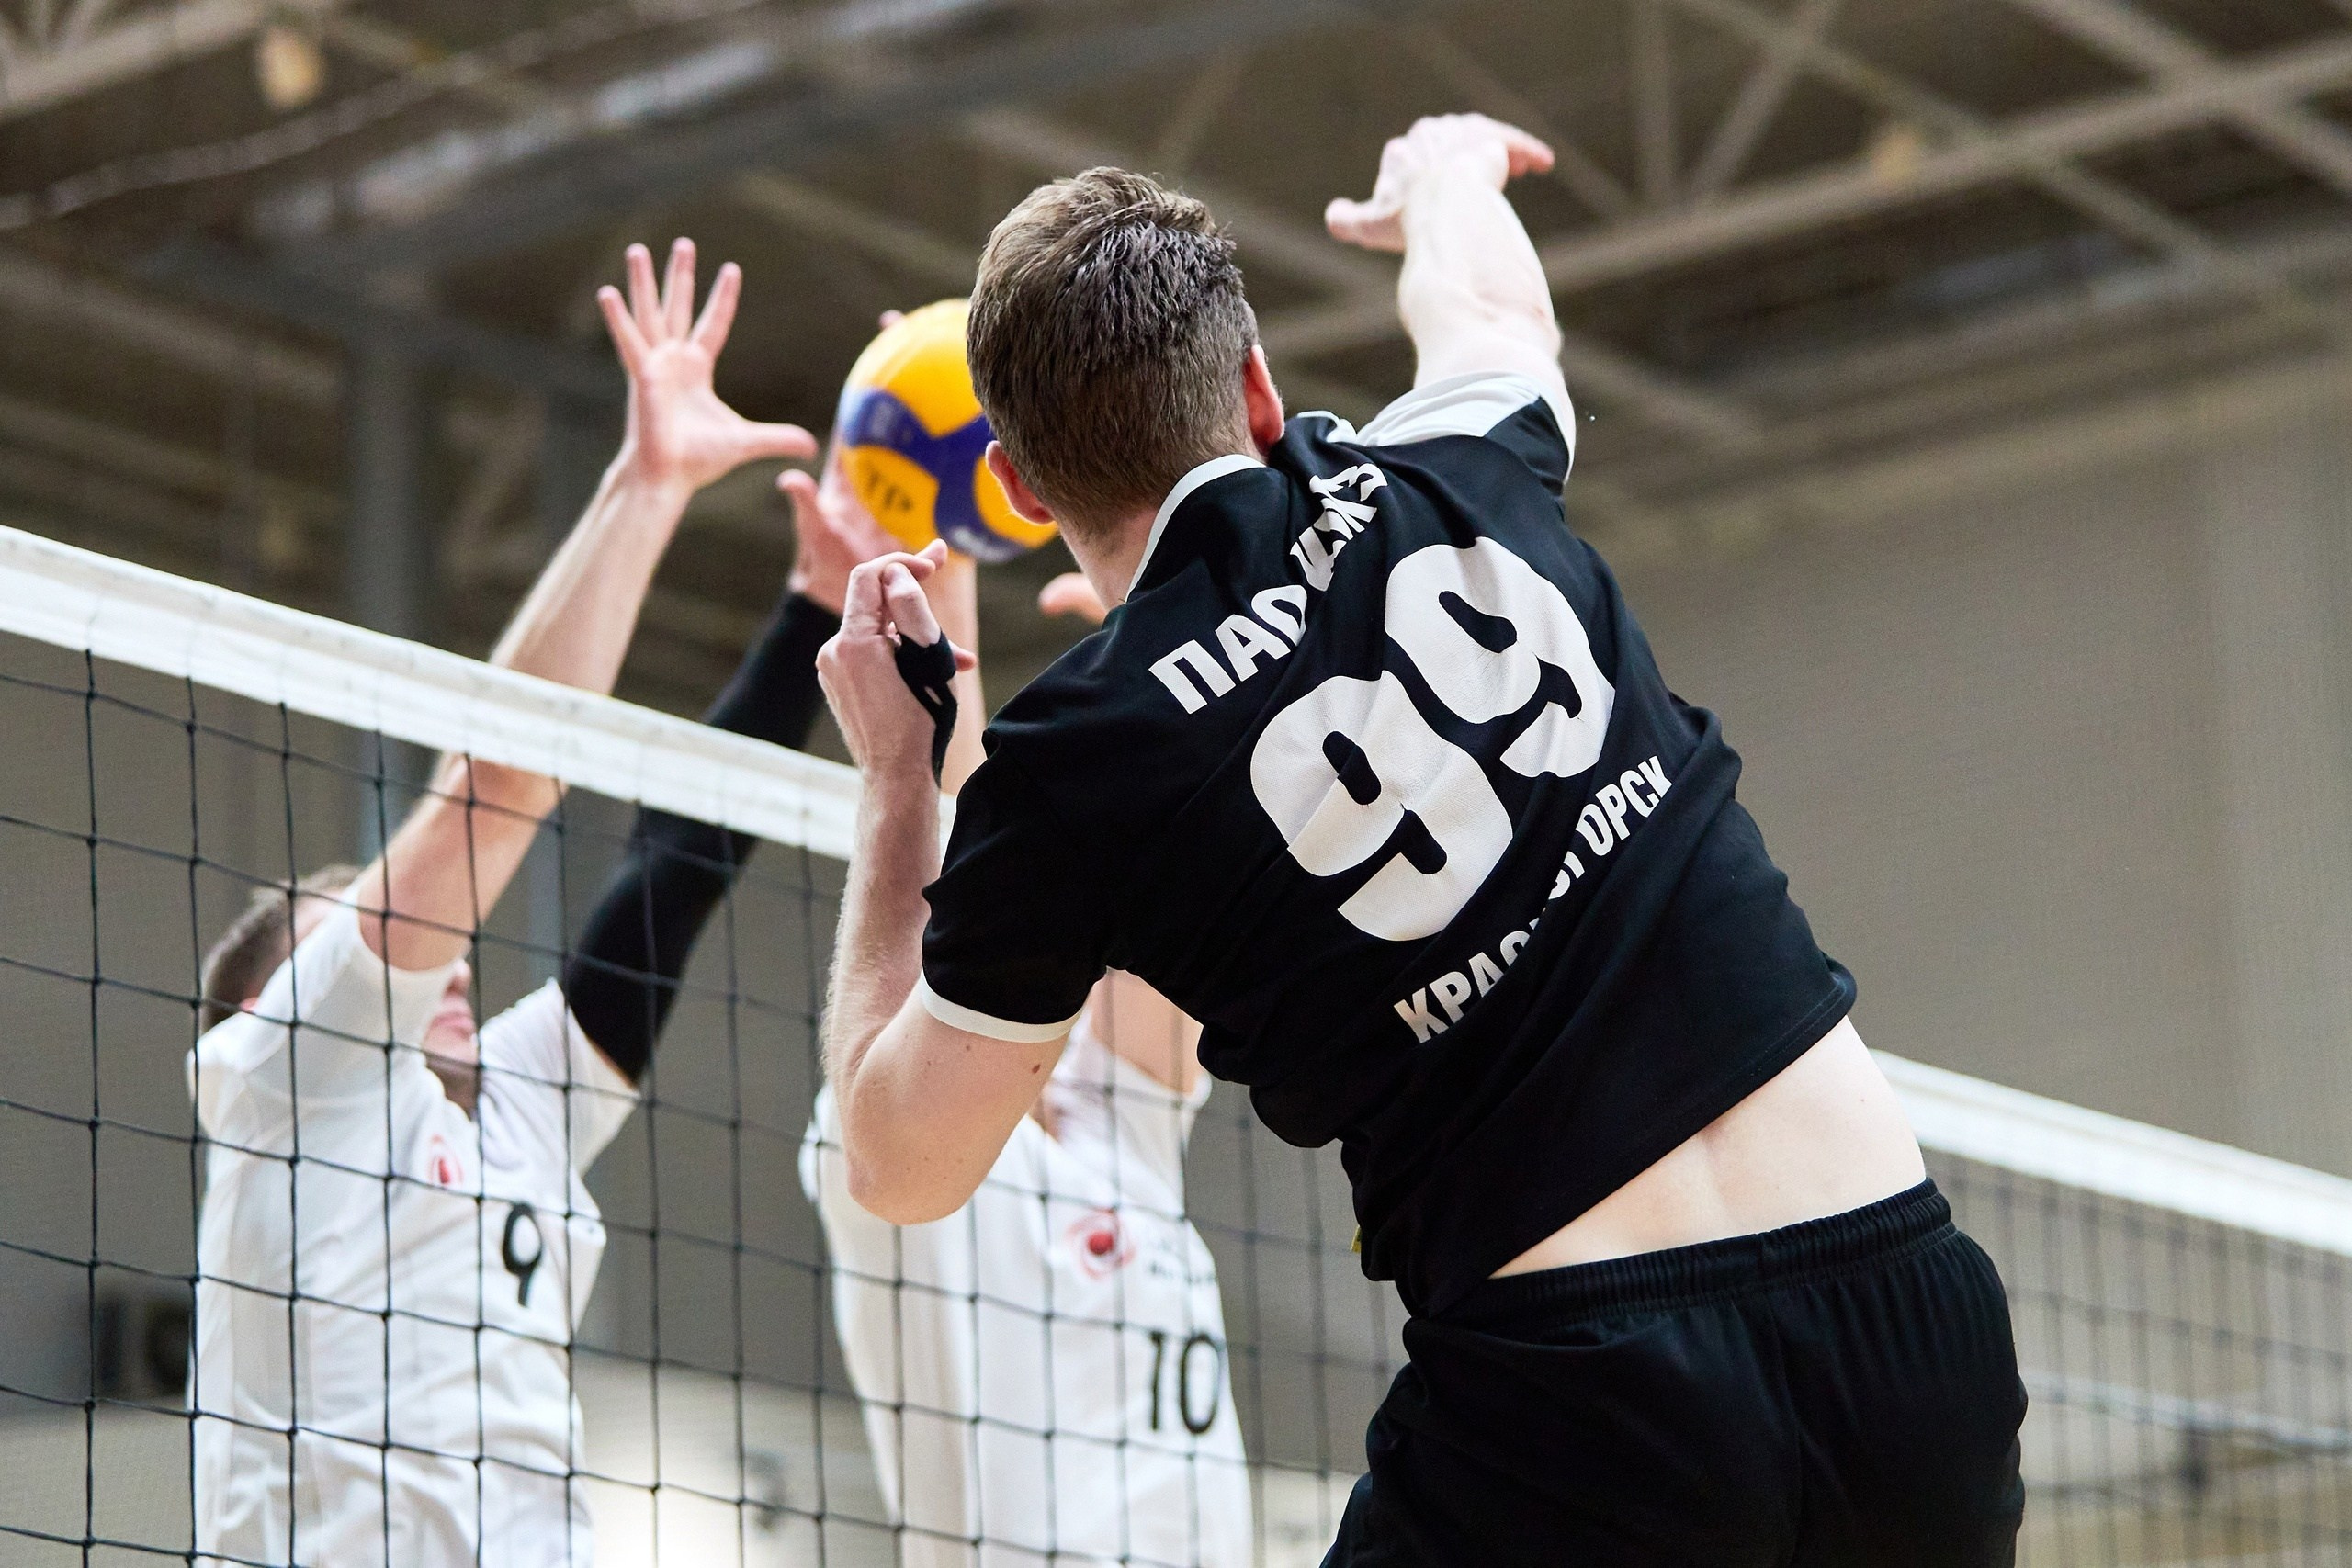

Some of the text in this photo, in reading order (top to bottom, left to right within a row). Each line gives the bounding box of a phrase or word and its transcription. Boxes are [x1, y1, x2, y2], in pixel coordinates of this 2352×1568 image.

[1250, 536, 1616, 942] 99
[502, 1202, 543, 1308] 9
[1150, 1331, 1220, 1435] 10
